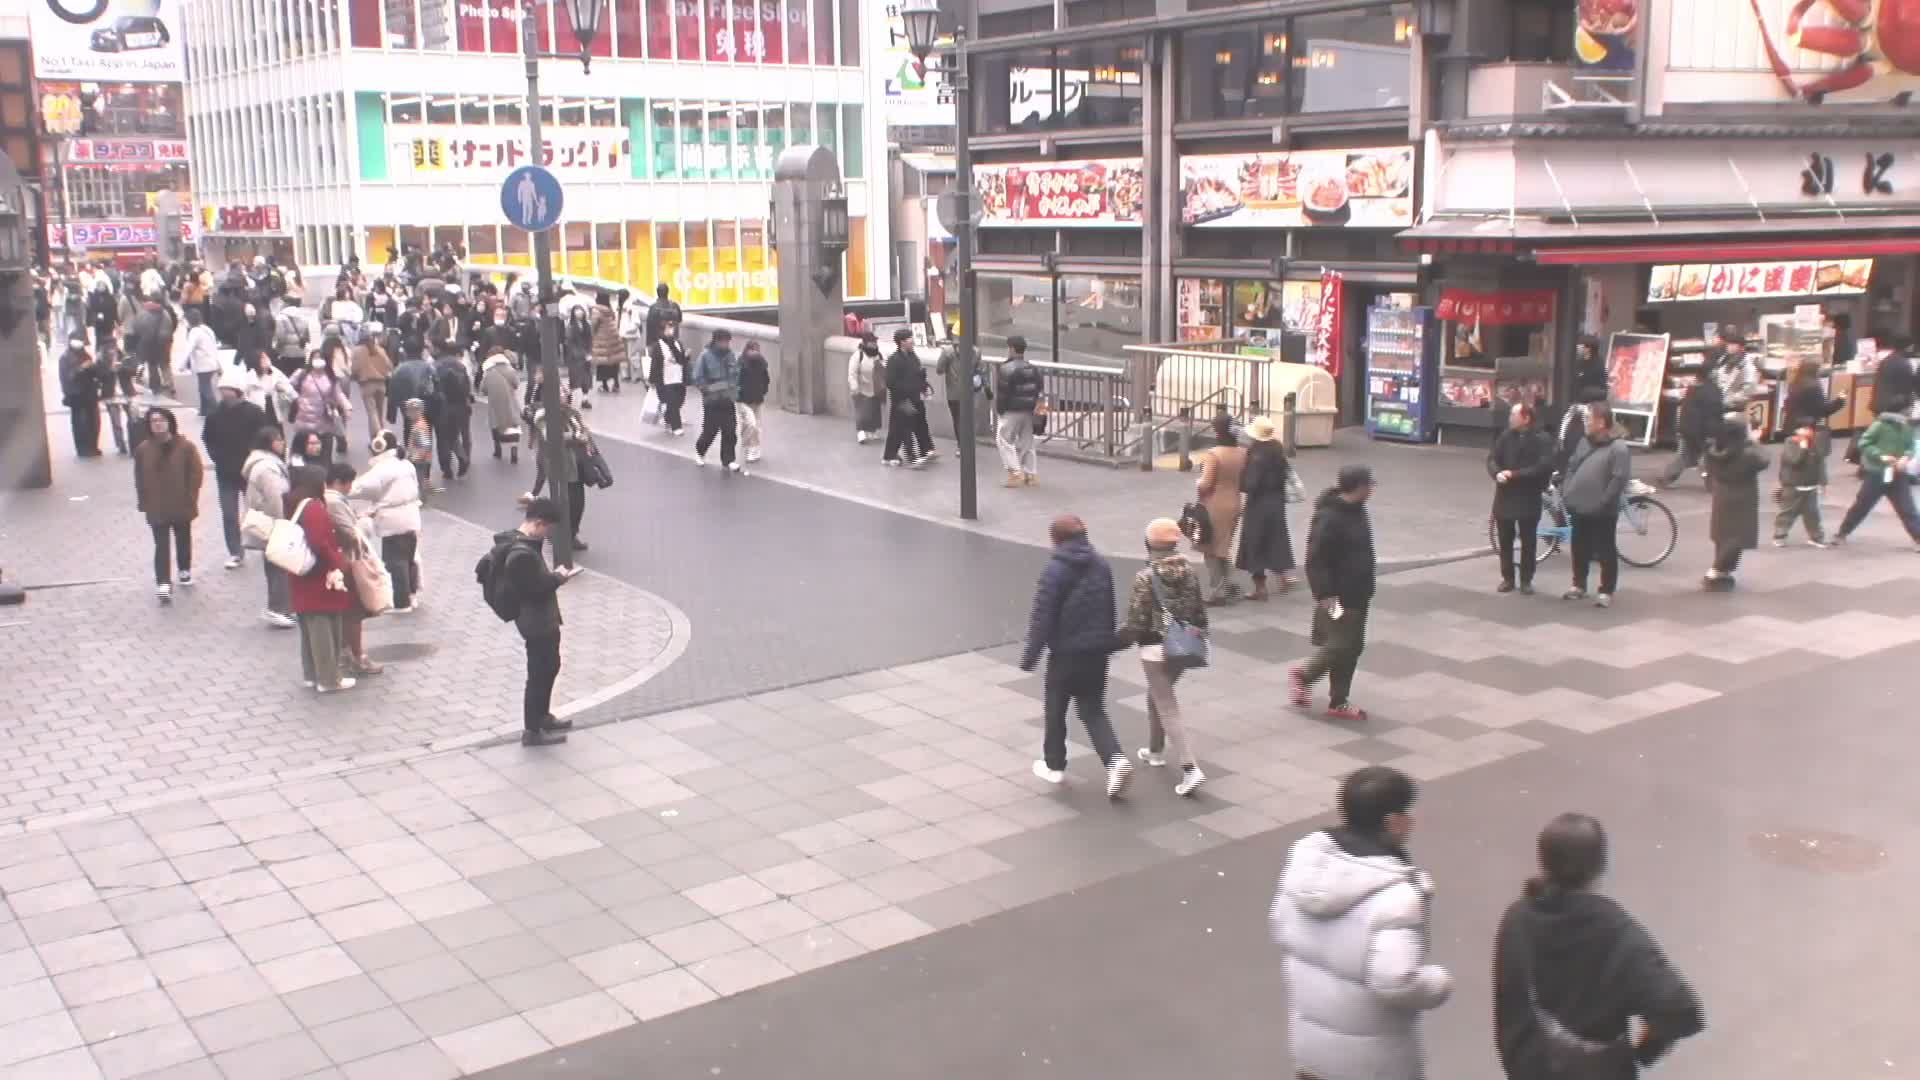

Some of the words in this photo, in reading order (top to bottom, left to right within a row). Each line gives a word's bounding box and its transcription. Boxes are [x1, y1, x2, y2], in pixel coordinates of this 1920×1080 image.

[459, 3, 499, 18] Photo
[501, 6, 527, 22] Spo
[709, 0, 755, 21] Free
[141, 60, 176, 71] Japan
